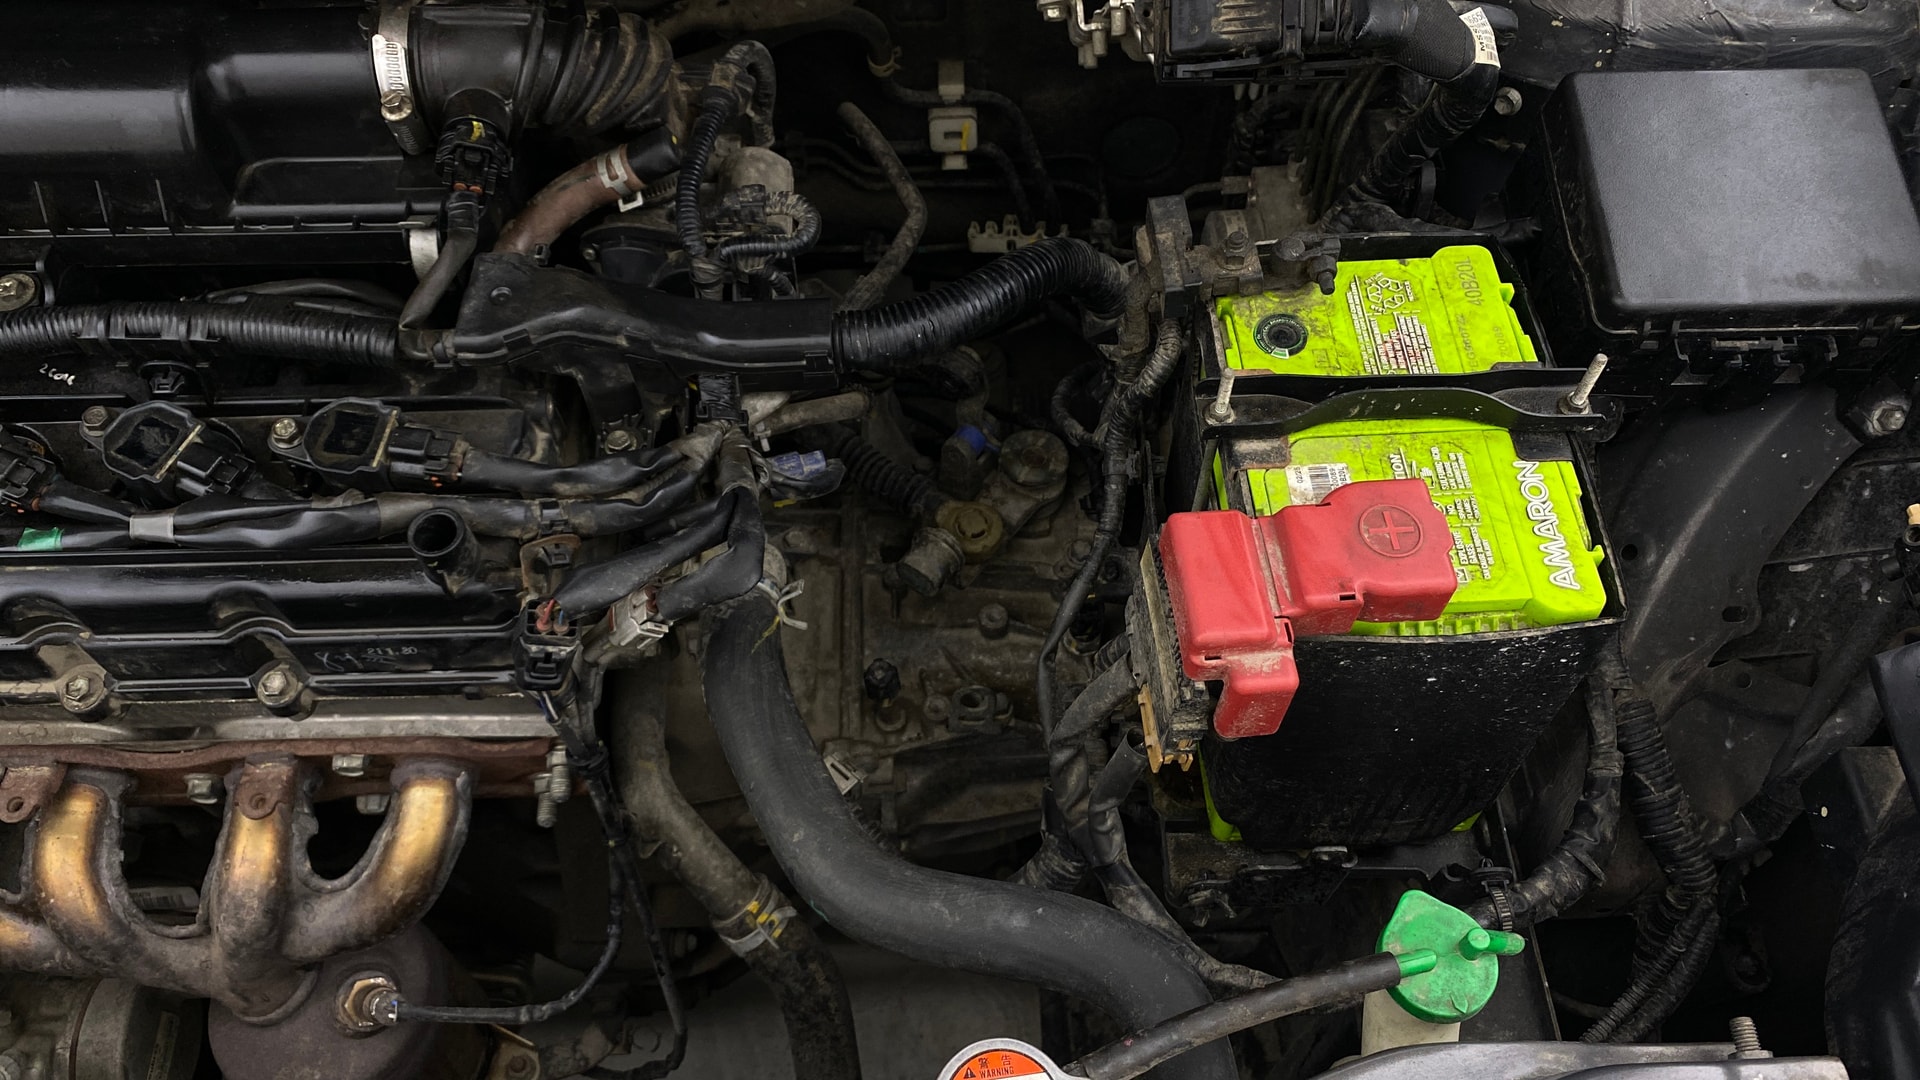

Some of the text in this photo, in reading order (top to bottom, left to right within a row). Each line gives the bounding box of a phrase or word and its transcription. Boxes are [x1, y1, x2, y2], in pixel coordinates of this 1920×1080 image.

[1454, 256, 1484, 306] 40B20L
[1447, 504, 1456, 515] NO
[1513, 461, 1580, 590] AMARON
[1453, 530, 1469, 565] EXPLOSIVE
[1466, 544, 1478, 564] GASES
[980, 1066, 1014, 1079] WARNING
